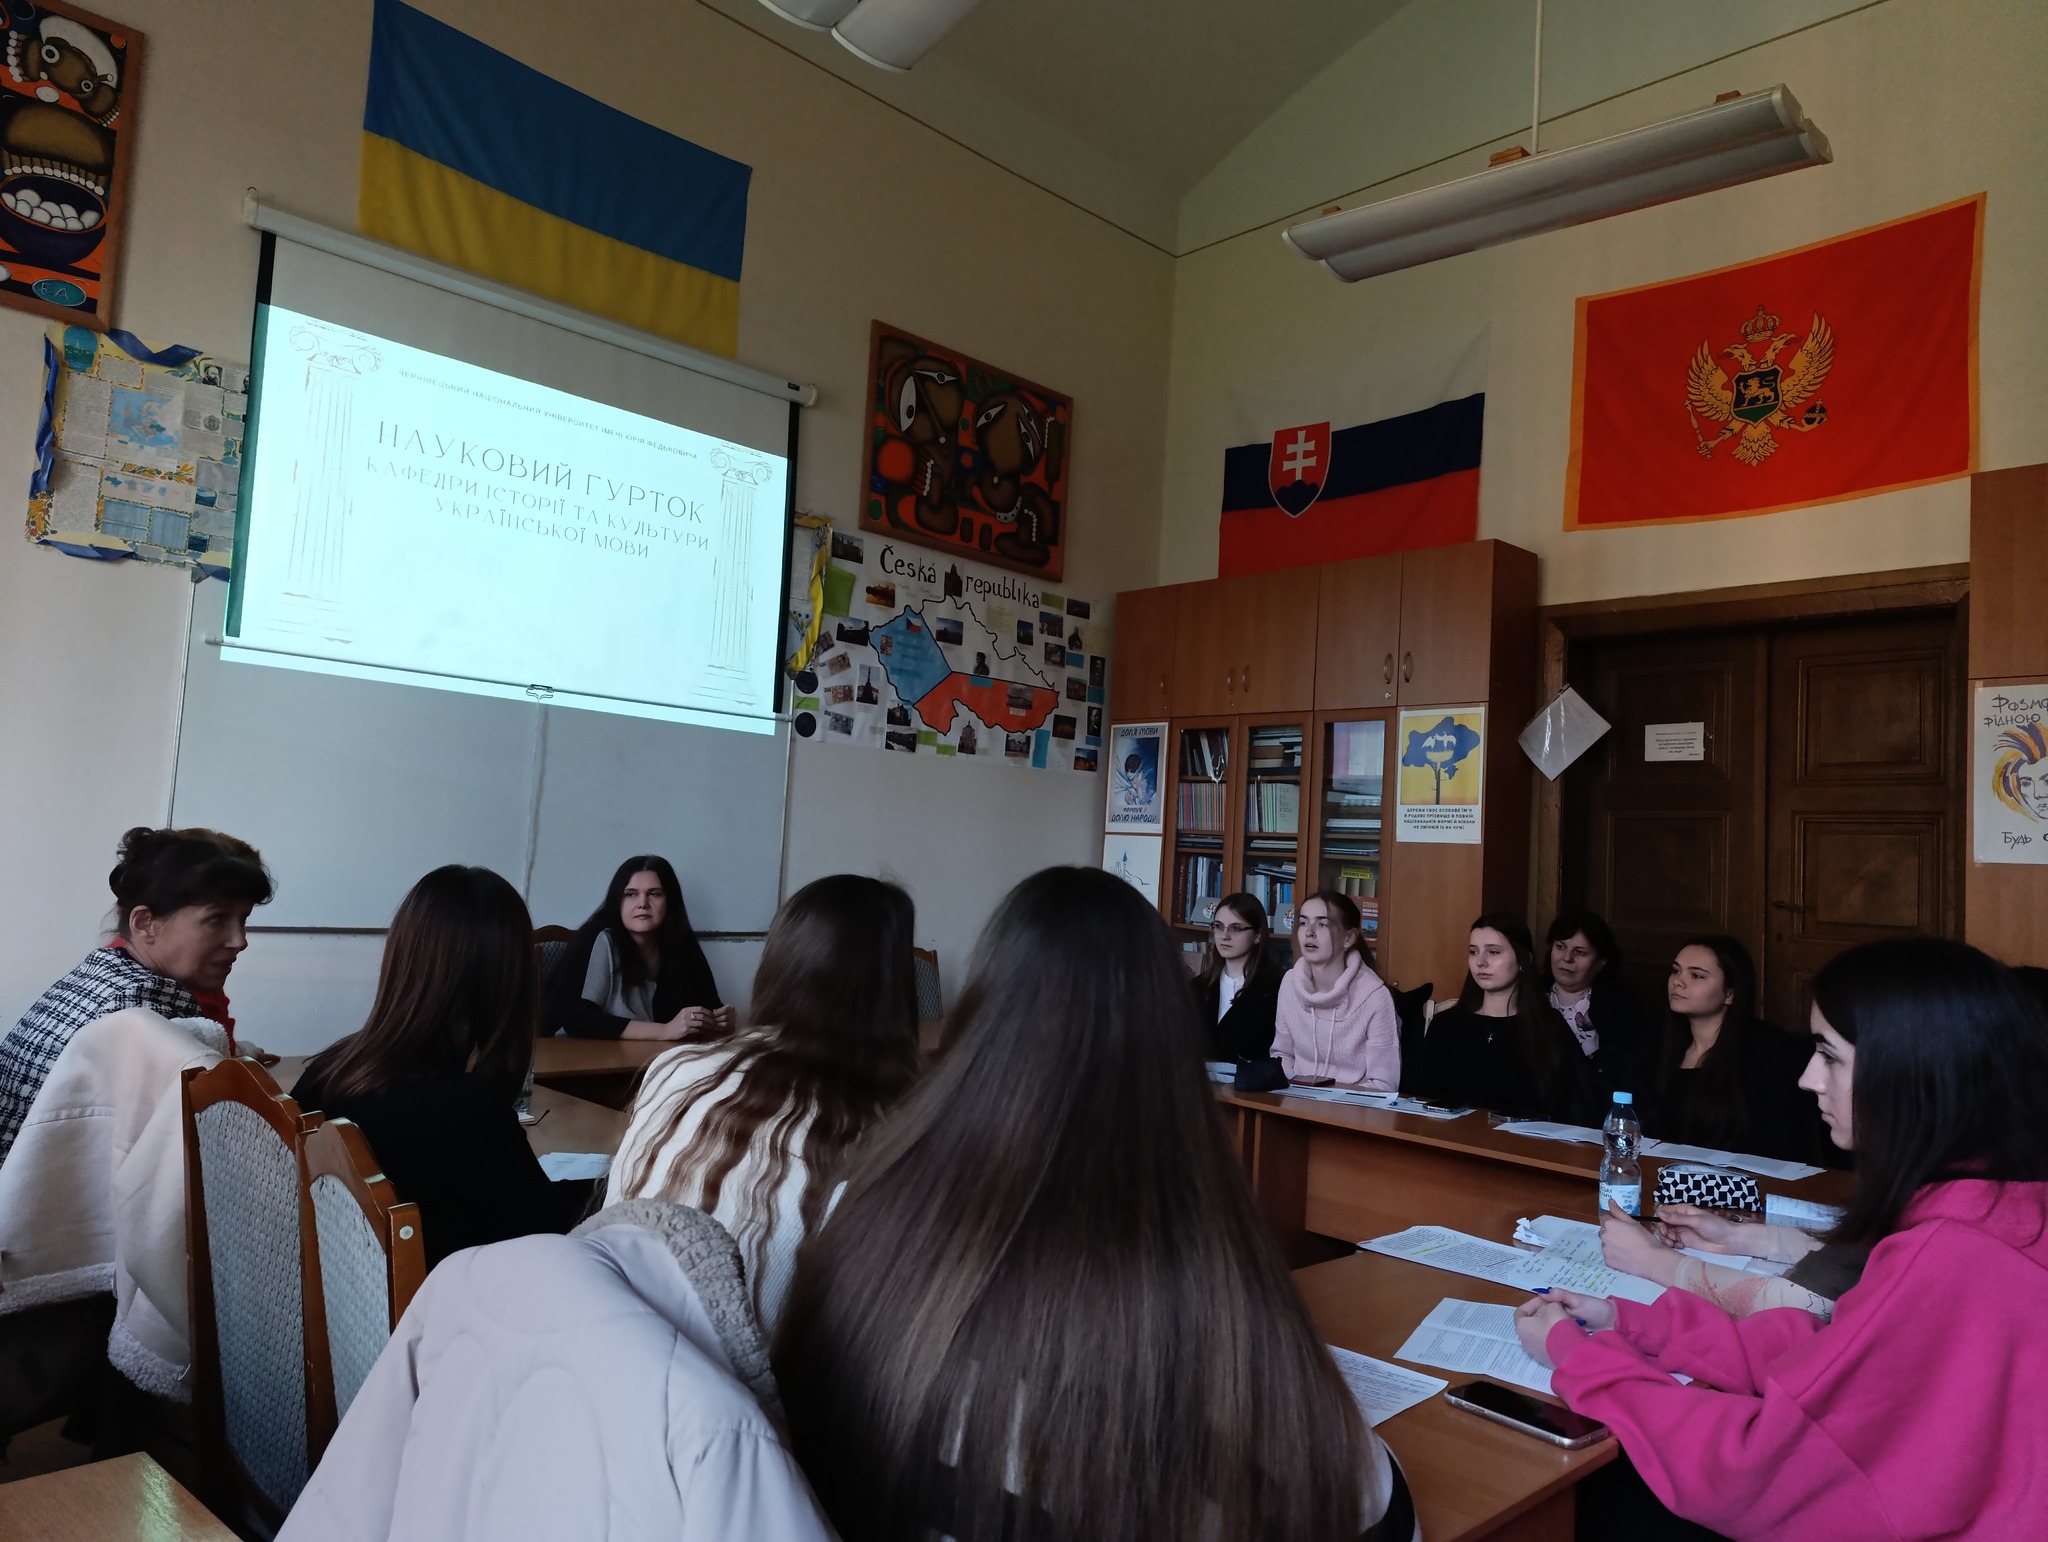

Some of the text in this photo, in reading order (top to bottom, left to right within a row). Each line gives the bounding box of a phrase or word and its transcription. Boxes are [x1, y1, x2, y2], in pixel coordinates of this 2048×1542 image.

[398, 369, 698, 460] ЧЕРНІВЕЦЬКИЙ НАЦІОНАЛЬНИЙ УНІВЕРСИТЕТ ІМЕНІ ЮРІЯ ФЕДЬКОВИЧА
[367, 456, 709, 551] КАФЕДРИ ІСТОРІЇ ТА КУЛЬТУРИ
[379, 420, 704, 524] НАУКОВИЙ ГУРТОК
[436, 497, 649, 559] УКРАЇНСЬКОЇ МОВИ
[880, 544, 937, 584] Česká
[965, 576, 1040, 609] republika
[1120, 727, 1159, 737] ДОЛЯ МОВИ
[1111, 814, 1157, 823] ДОЛЮ НАРОДУ
[2001, 831, 2032, 849] Будь
